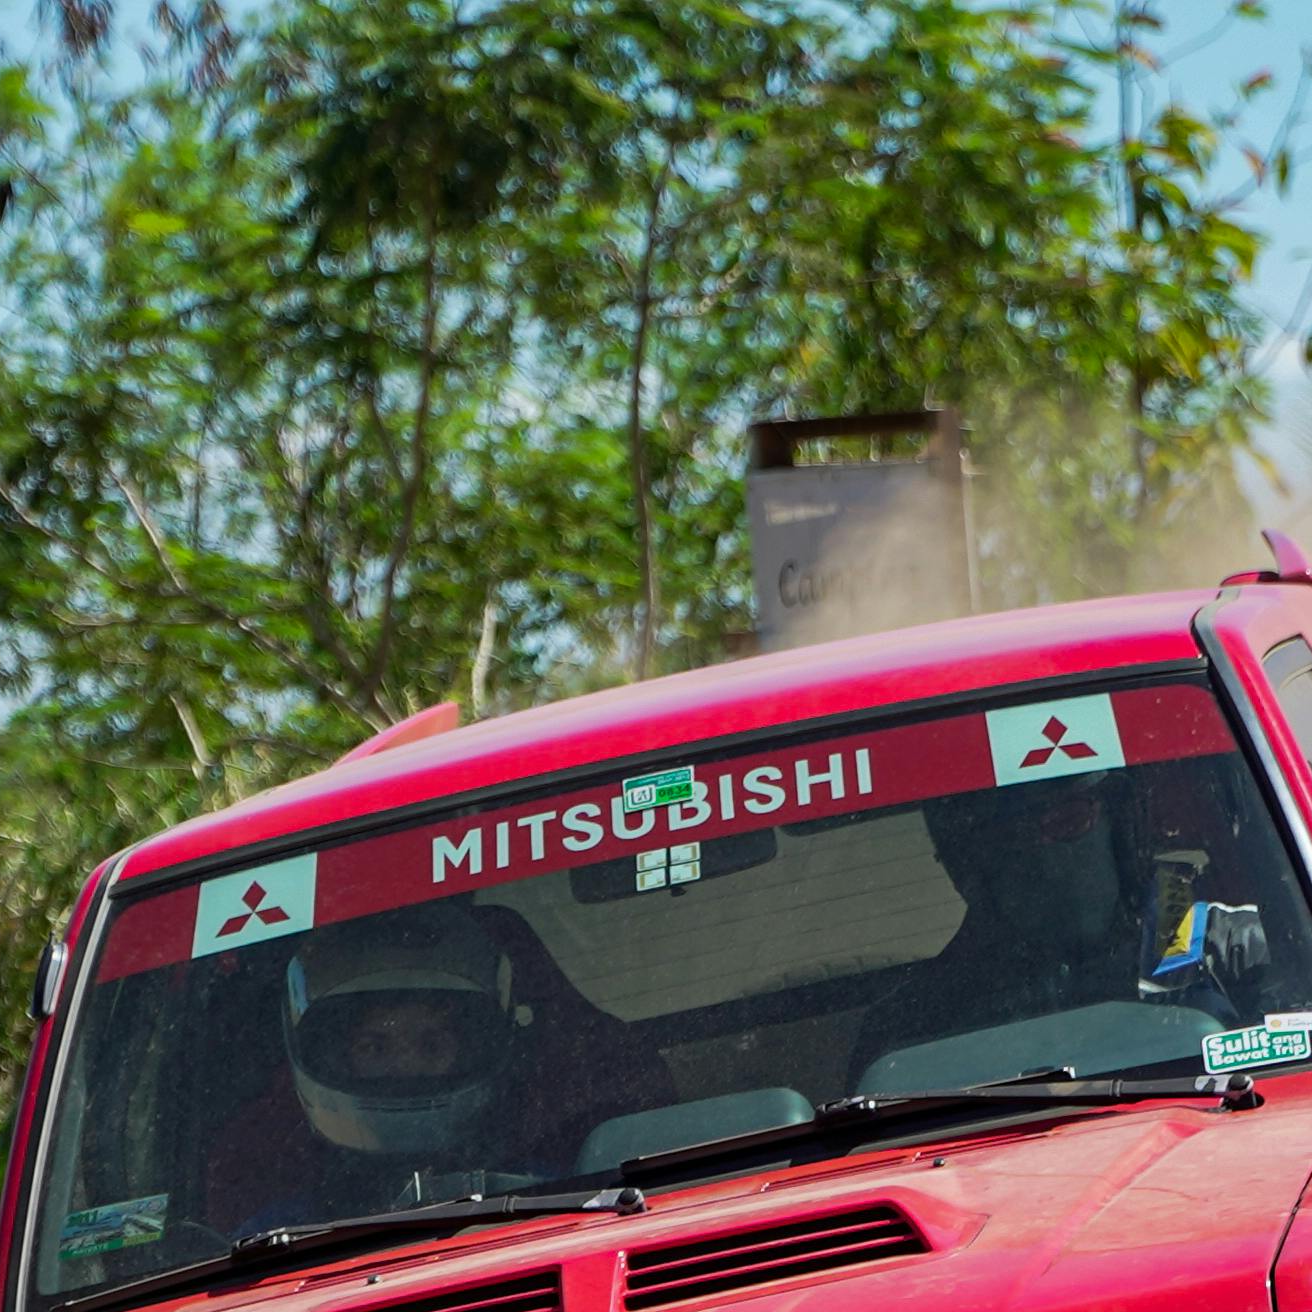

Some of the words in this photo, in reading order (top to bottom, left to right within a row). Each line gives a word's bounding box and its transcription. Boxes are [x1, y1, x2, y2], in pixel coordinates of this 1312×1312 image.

[432, 748, 873, 883] MITSUBISHI
[1208, 1030, 1271, 1056] Sulit
[1272, 1033, 1303, 1047] ang
[1210, 1047, 1270, 1067] Bawat
[1272, 1043, 1306, 1057] Trip
